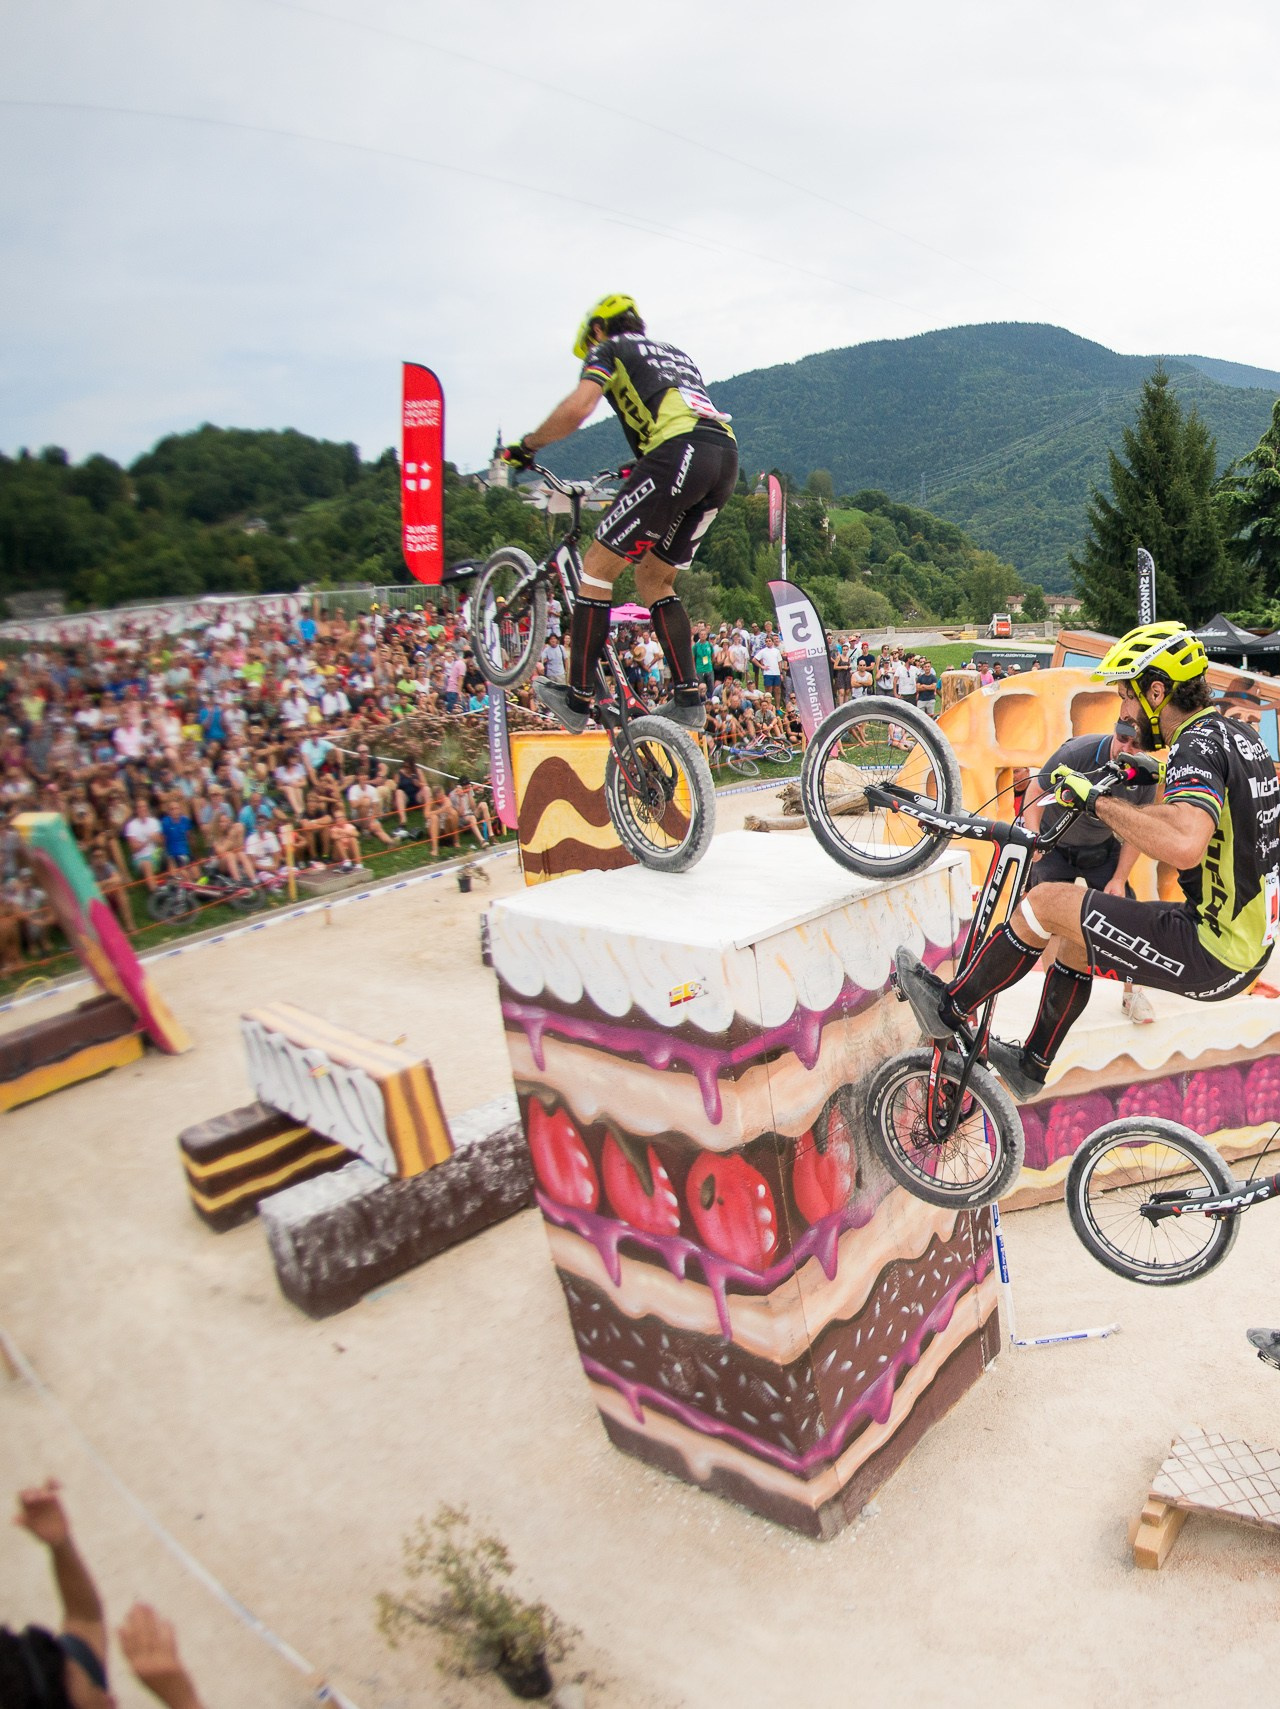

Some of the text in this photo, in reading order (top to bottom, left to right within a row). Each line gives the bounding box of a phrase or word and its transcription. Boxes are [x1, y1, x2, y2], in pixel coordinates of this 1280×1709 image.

[404, 401, 440, 409] SAVOIE
[404, 418, 440, 427] BLANC
[595, 477, 656, 541] hebo
[900, 805, 971, 834] CLEAN
[1005, 928, 1027, 953] hebo
[1082, 909, 1185, 977] hebo
[1182, 1190, 1256, 1212] CLEAN
